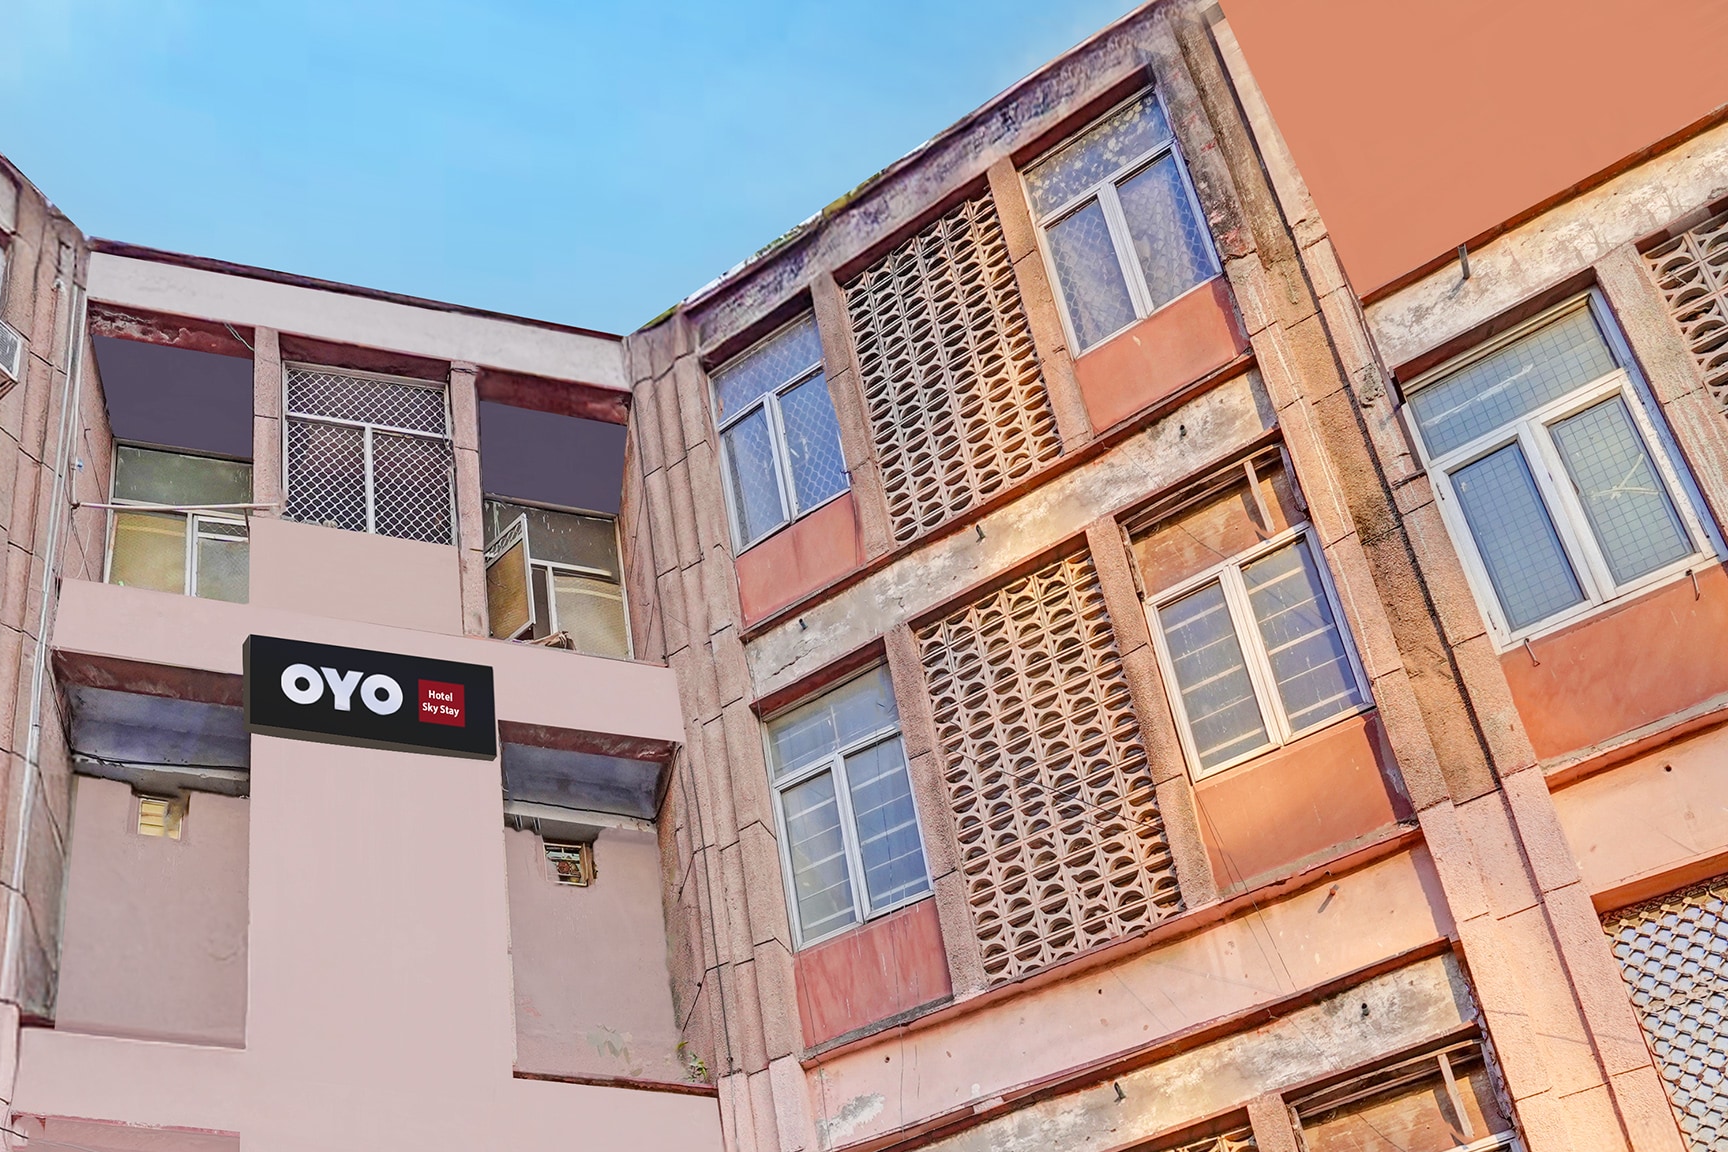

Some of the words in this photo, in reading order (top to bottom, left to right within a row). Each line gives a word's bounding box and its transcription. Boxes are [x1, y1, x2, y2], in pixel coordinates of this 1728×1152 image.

[280, 663, 404, 716] OYO
[428, 690, 453, 702] Hotel
[422, 702, 439, 715] Sky
[440, 705, 460, 718] Stay
